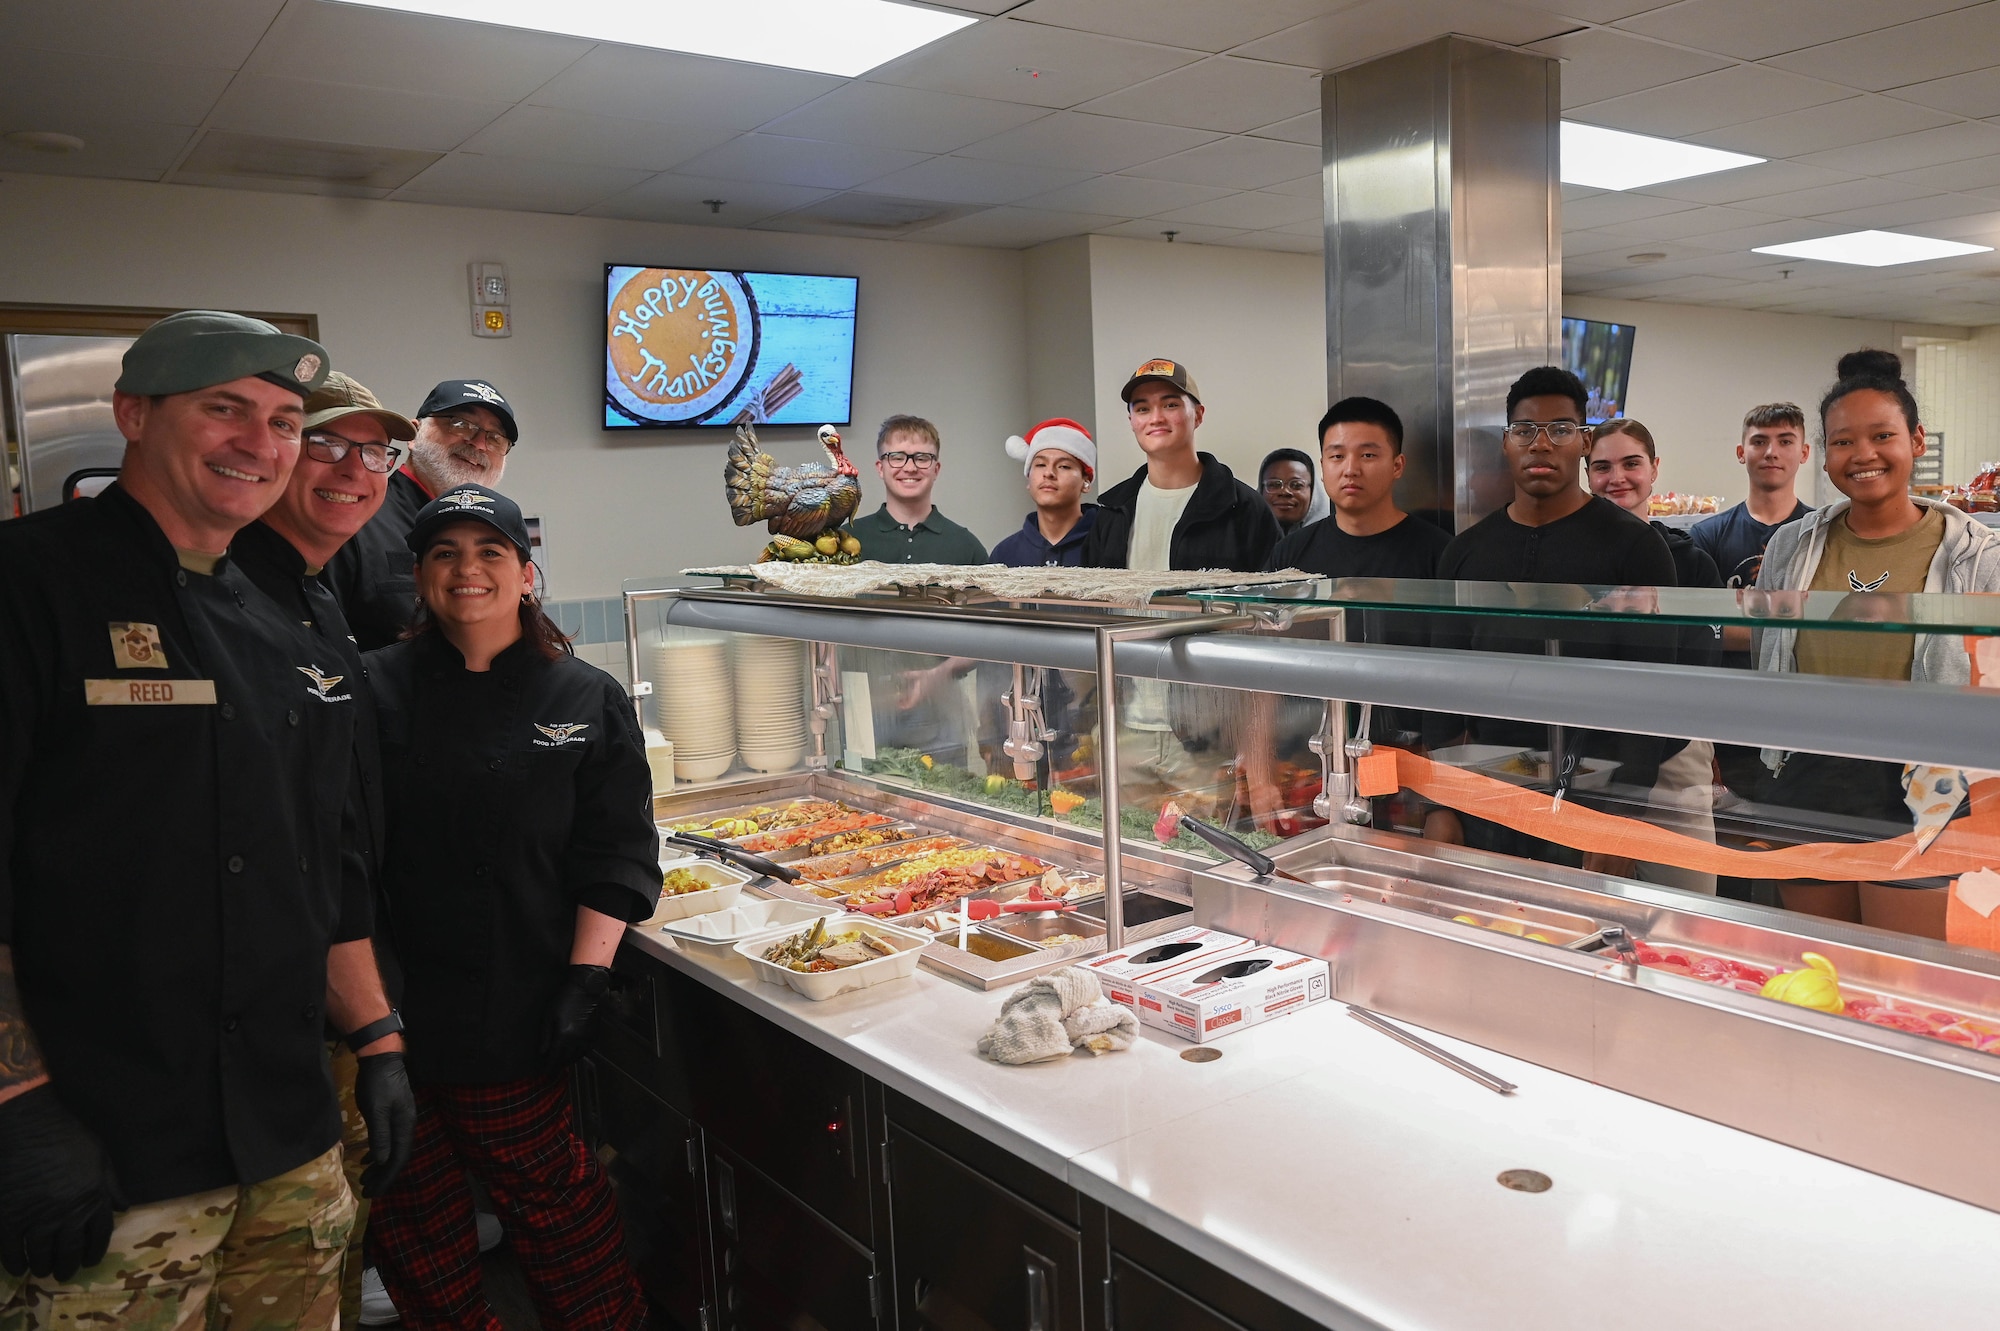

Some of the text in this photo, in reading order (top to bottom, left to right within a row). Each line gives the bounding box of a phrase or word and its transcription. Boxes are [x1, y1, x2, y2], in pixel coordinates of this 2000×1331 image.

[613, 275, 737, 398] Happy Thanksgiving
[129, 683, 174, 702] REED
[1264, 991, 1276, 1001] Black
[1289, 984, 1304, 992] Gloves
[1266, 978, 1303, 994] High Performance
[1213, 1003, 1232, 1015] Sysco
[1210, 1013, 1236, 1029] Classic
